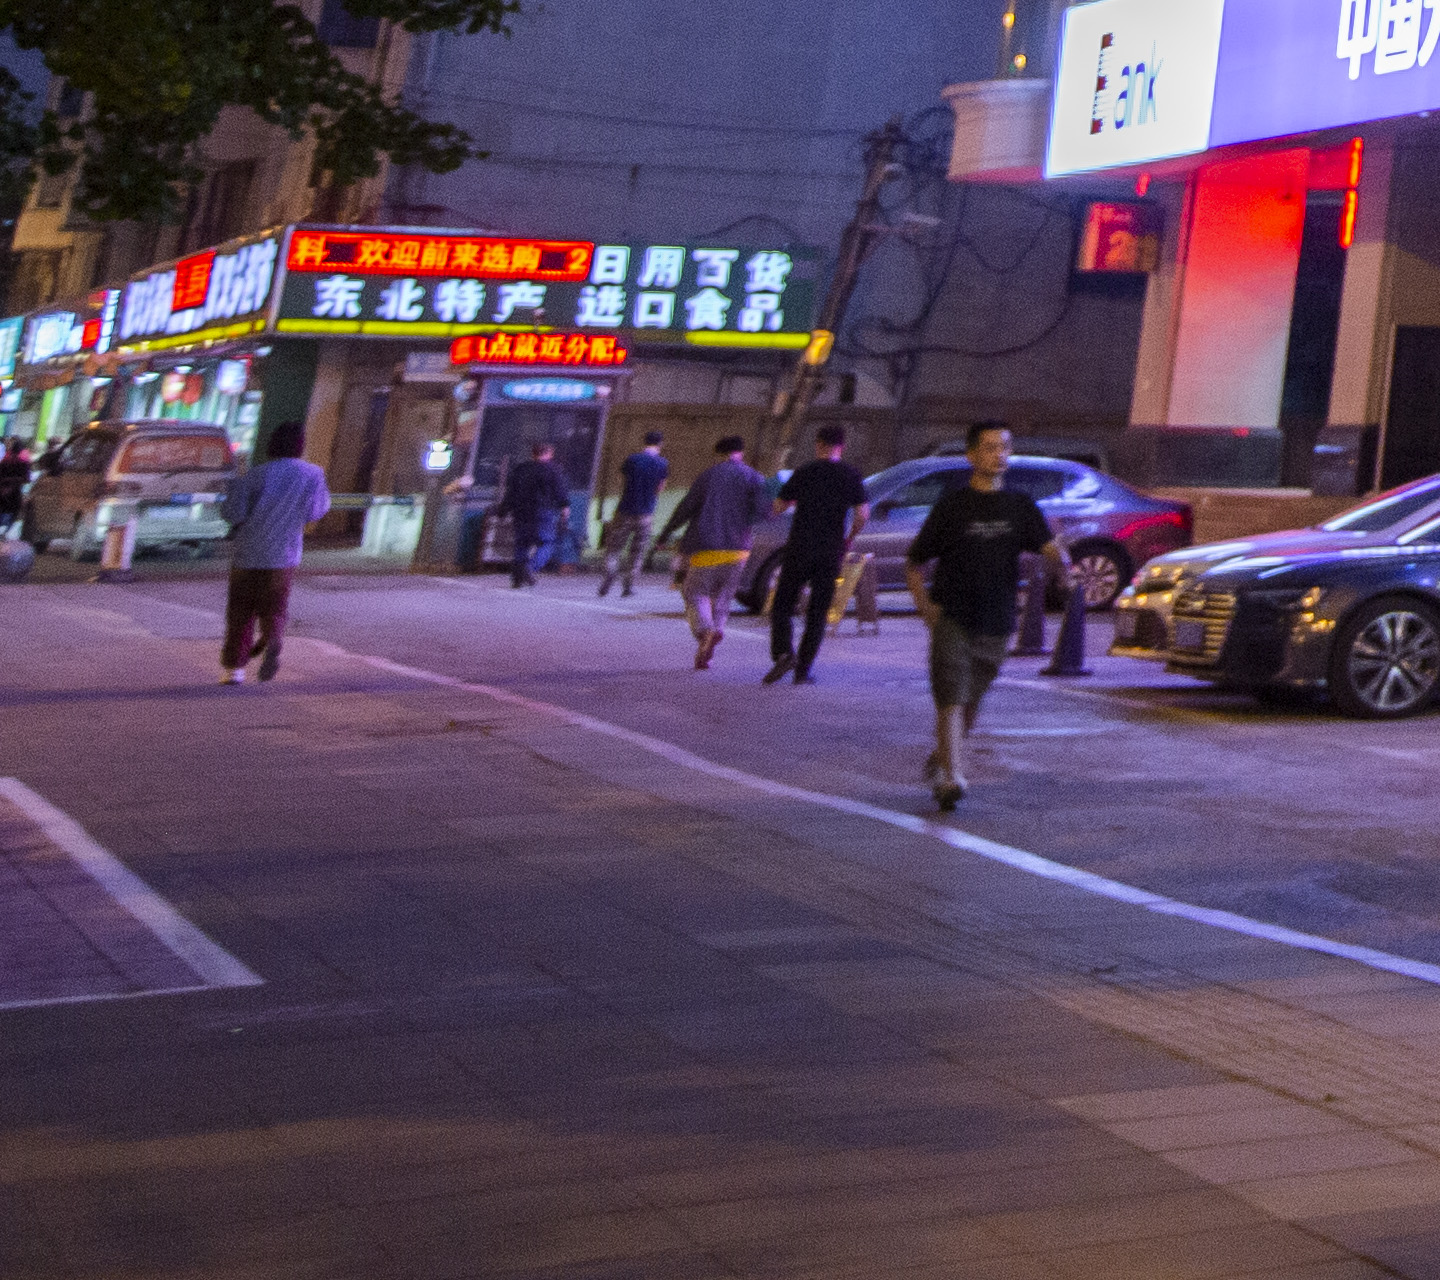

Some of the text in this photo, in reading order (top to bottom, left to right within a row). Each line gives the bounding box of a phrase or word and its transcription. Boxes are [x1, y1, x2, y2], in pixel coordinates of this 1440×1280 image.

[590, 245, 795, 292] 日用百货
[312, 274, 547, 323] 东北特产
[575, 285, 784, 331] 进口食品
